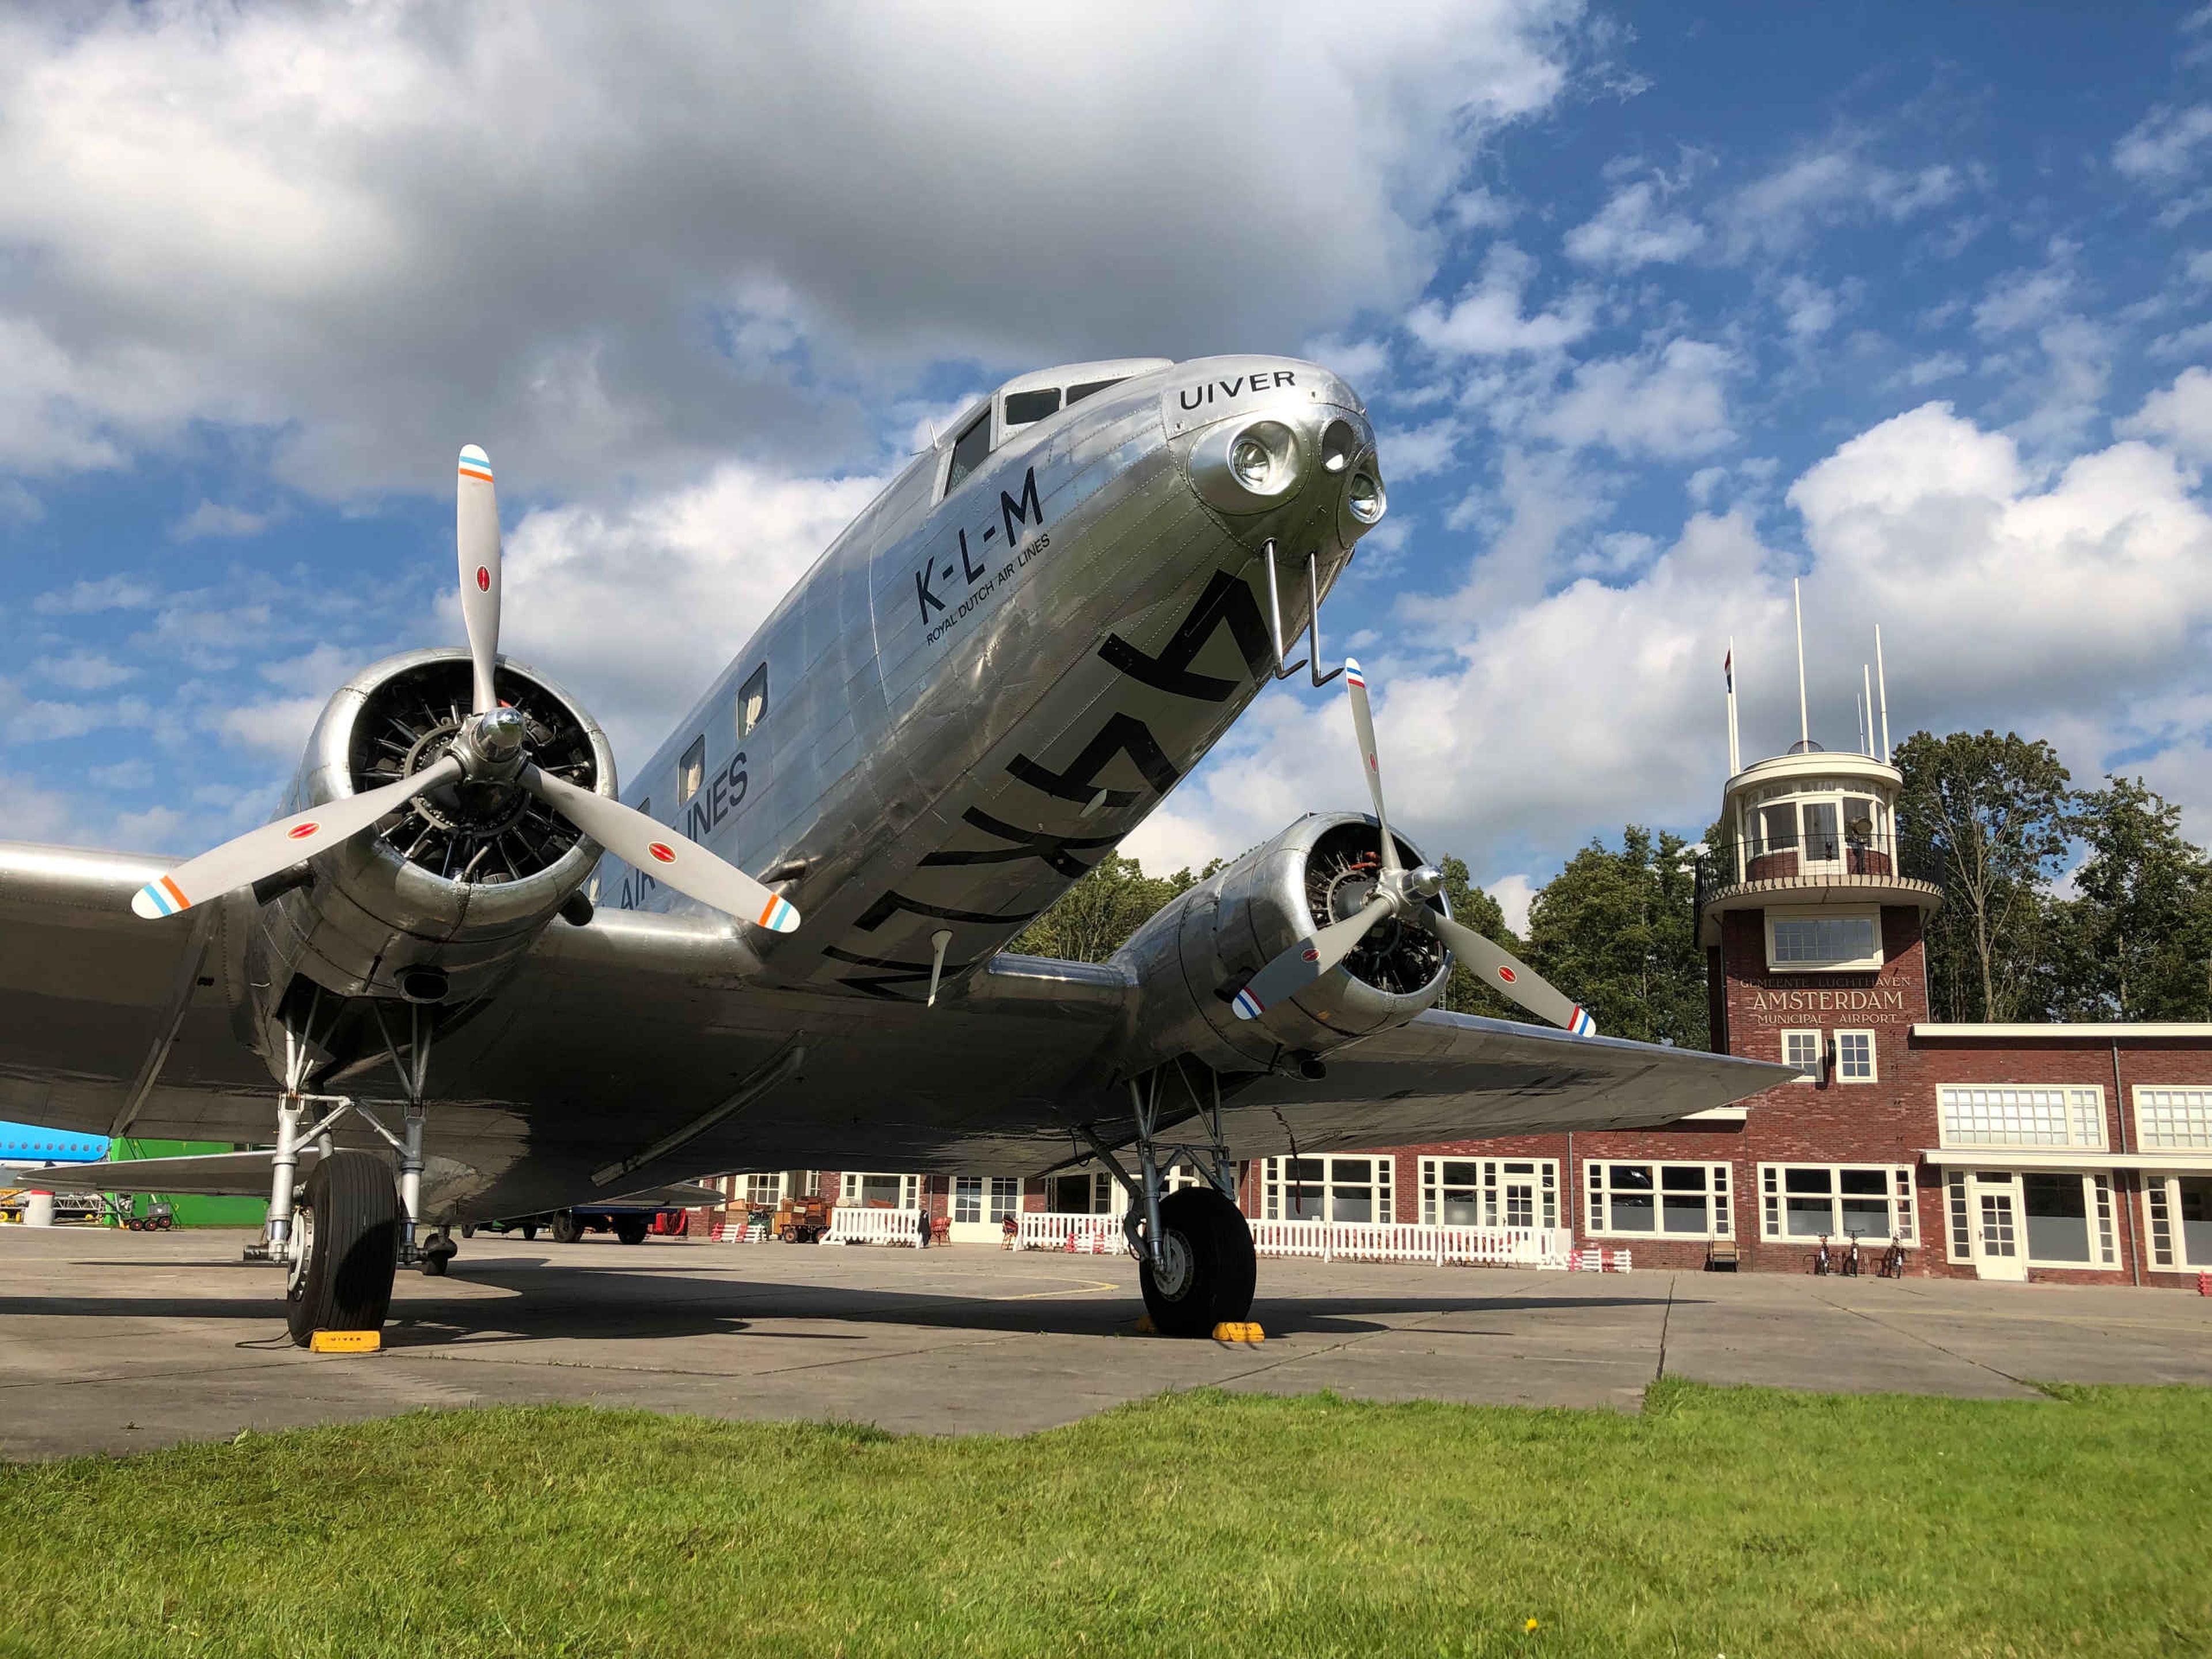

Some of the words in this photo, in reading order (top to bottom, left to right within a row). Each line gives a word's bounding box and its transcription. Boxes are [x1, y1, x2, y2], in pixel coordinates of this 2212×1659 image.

[1180, 370, 1296, 410] UIVER
[926, 615, 957, 646] ROYAL
[958, 581, 995, 618] DUTCH
[998, 563, 1014, 586] AIR
[1017, 533, 1050, 567] LINES
[672, 752, 748, 843] INES
[1819, 978, 1910, 987] LUCHTHAVEN
[1753, 991, 1904, 1010] AMSTERDAM
[1757, 1014, 1825, 1024] MUNICIPAL
[1839, 1013, 1899, 1024] AIRPORT
